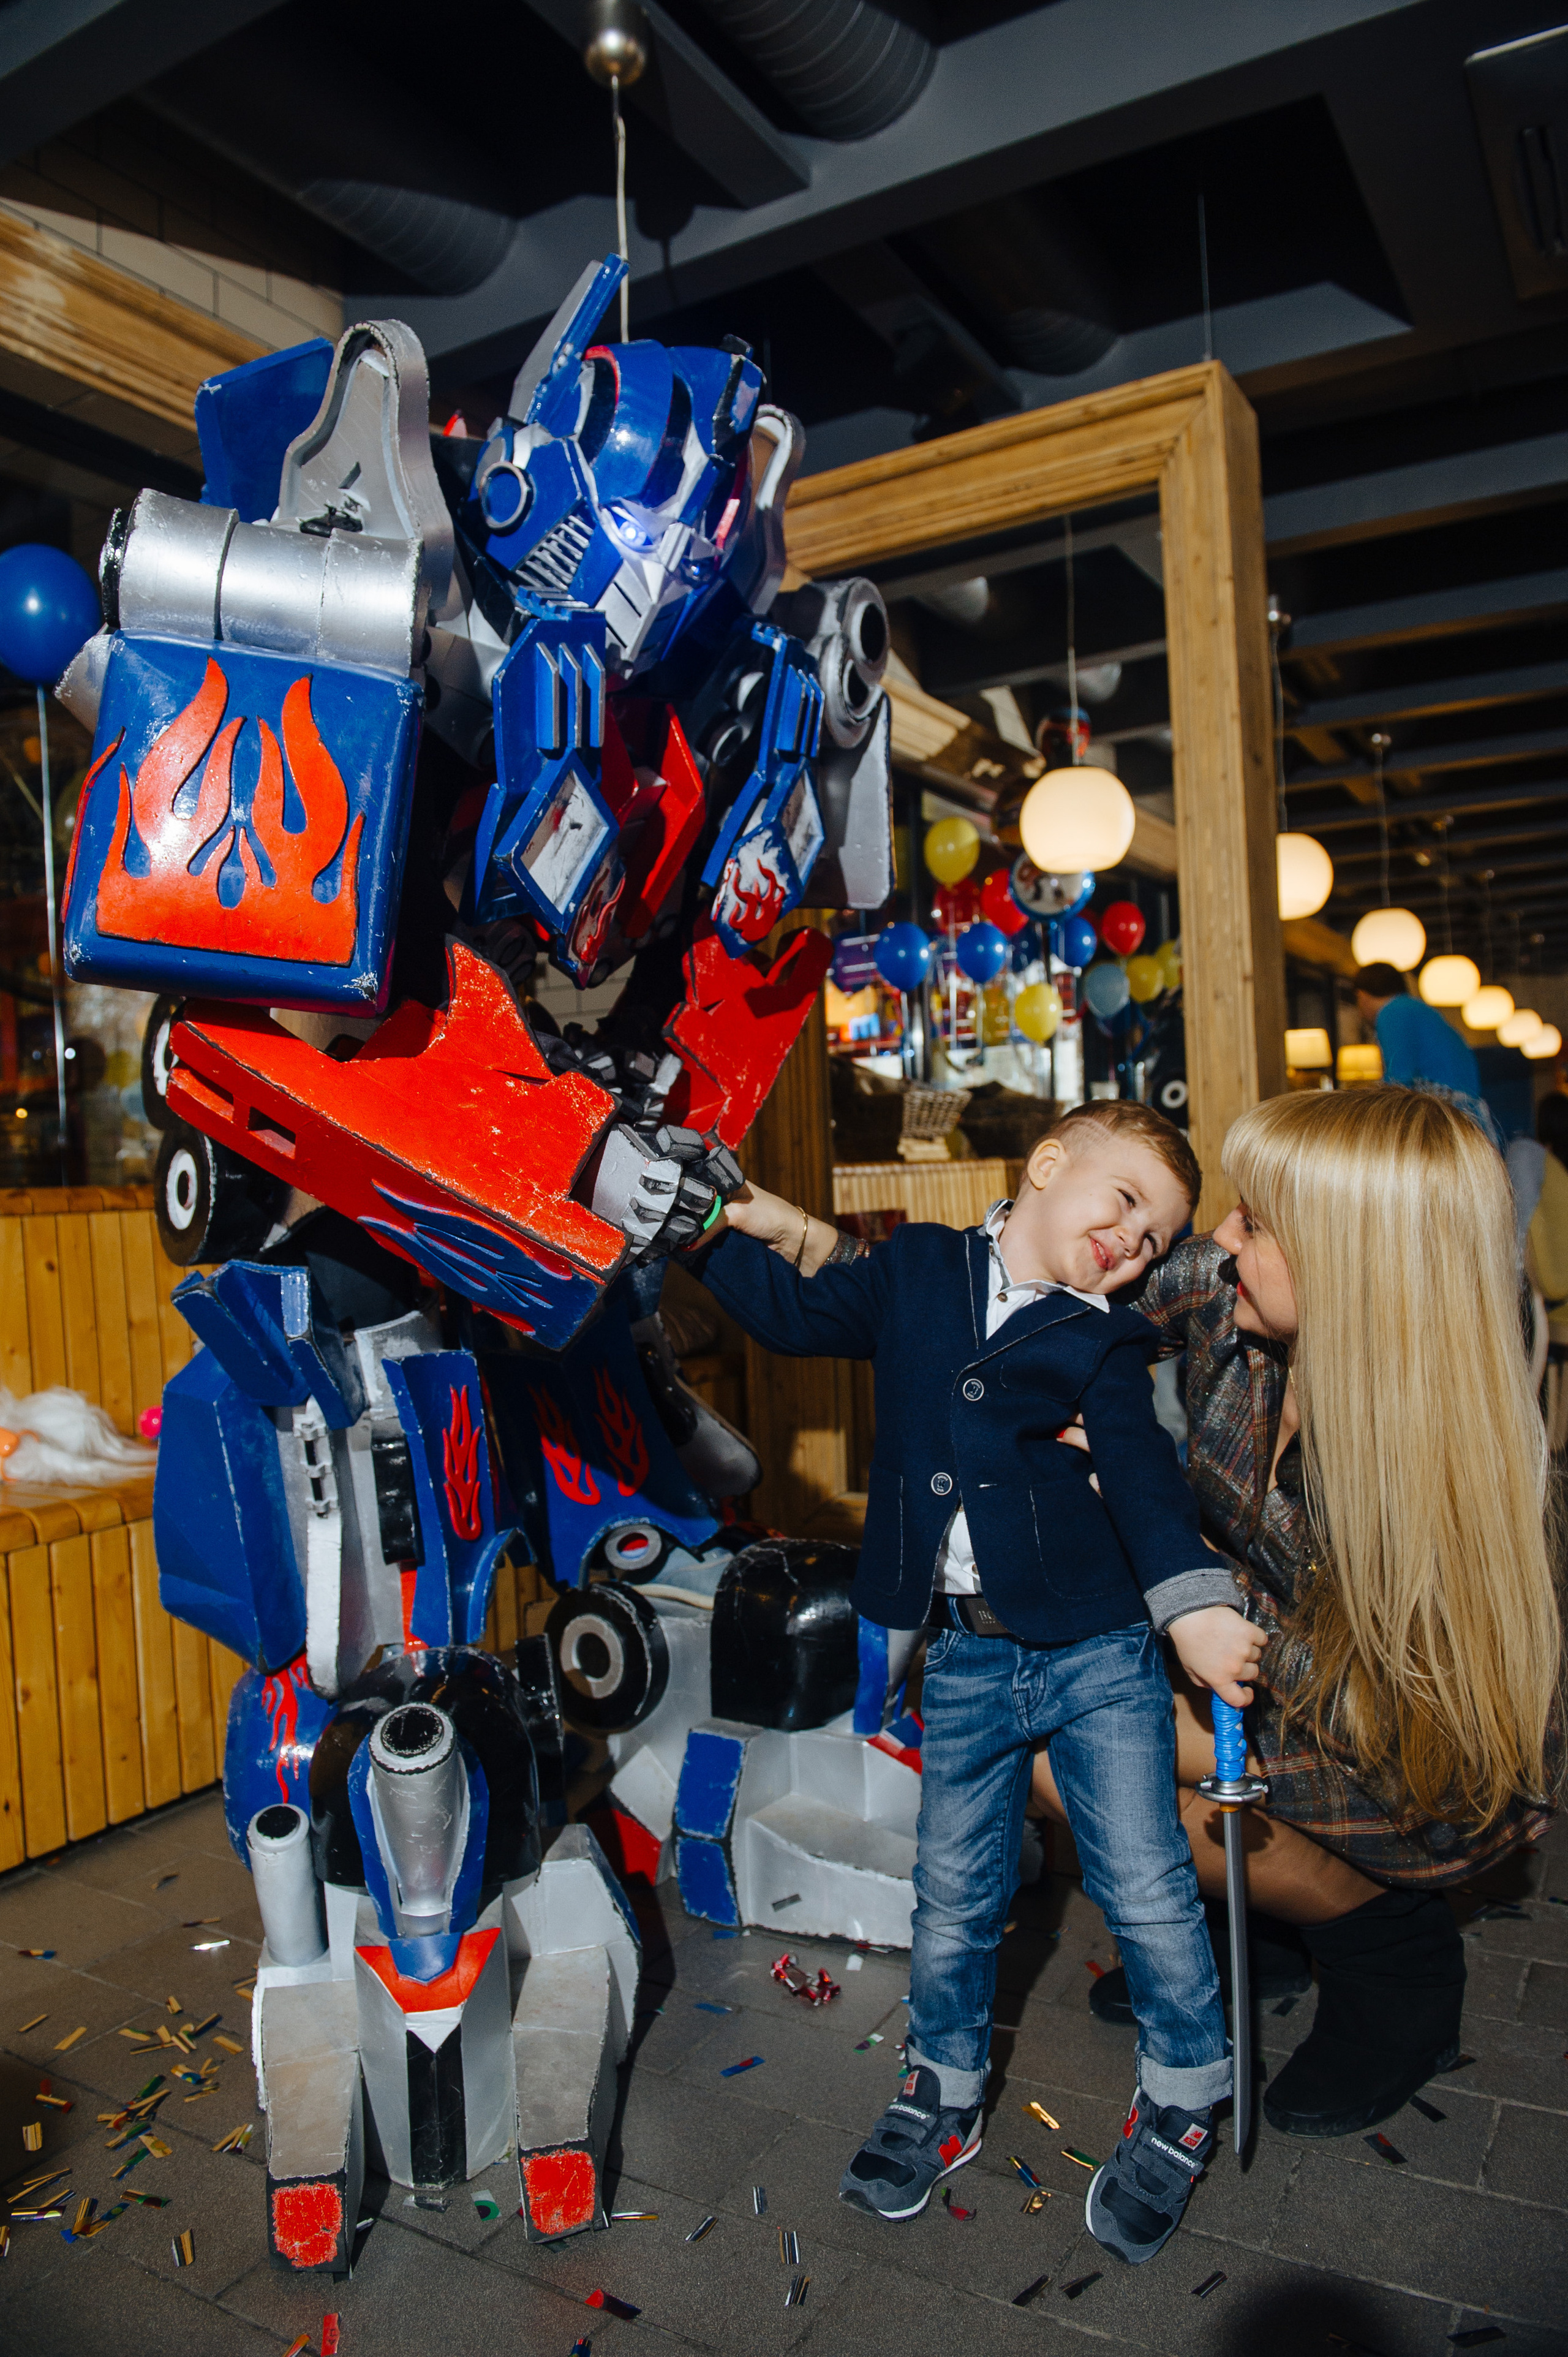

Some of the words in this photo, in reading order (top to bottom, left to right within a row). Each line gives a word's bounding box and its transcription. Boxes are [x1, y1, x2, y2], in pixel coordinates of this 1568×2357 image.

[899, 2105, 927, 2119] balance
[1152, 2137, 1169, 2151] new
[1168, 2146, 1196, 2168] balance
